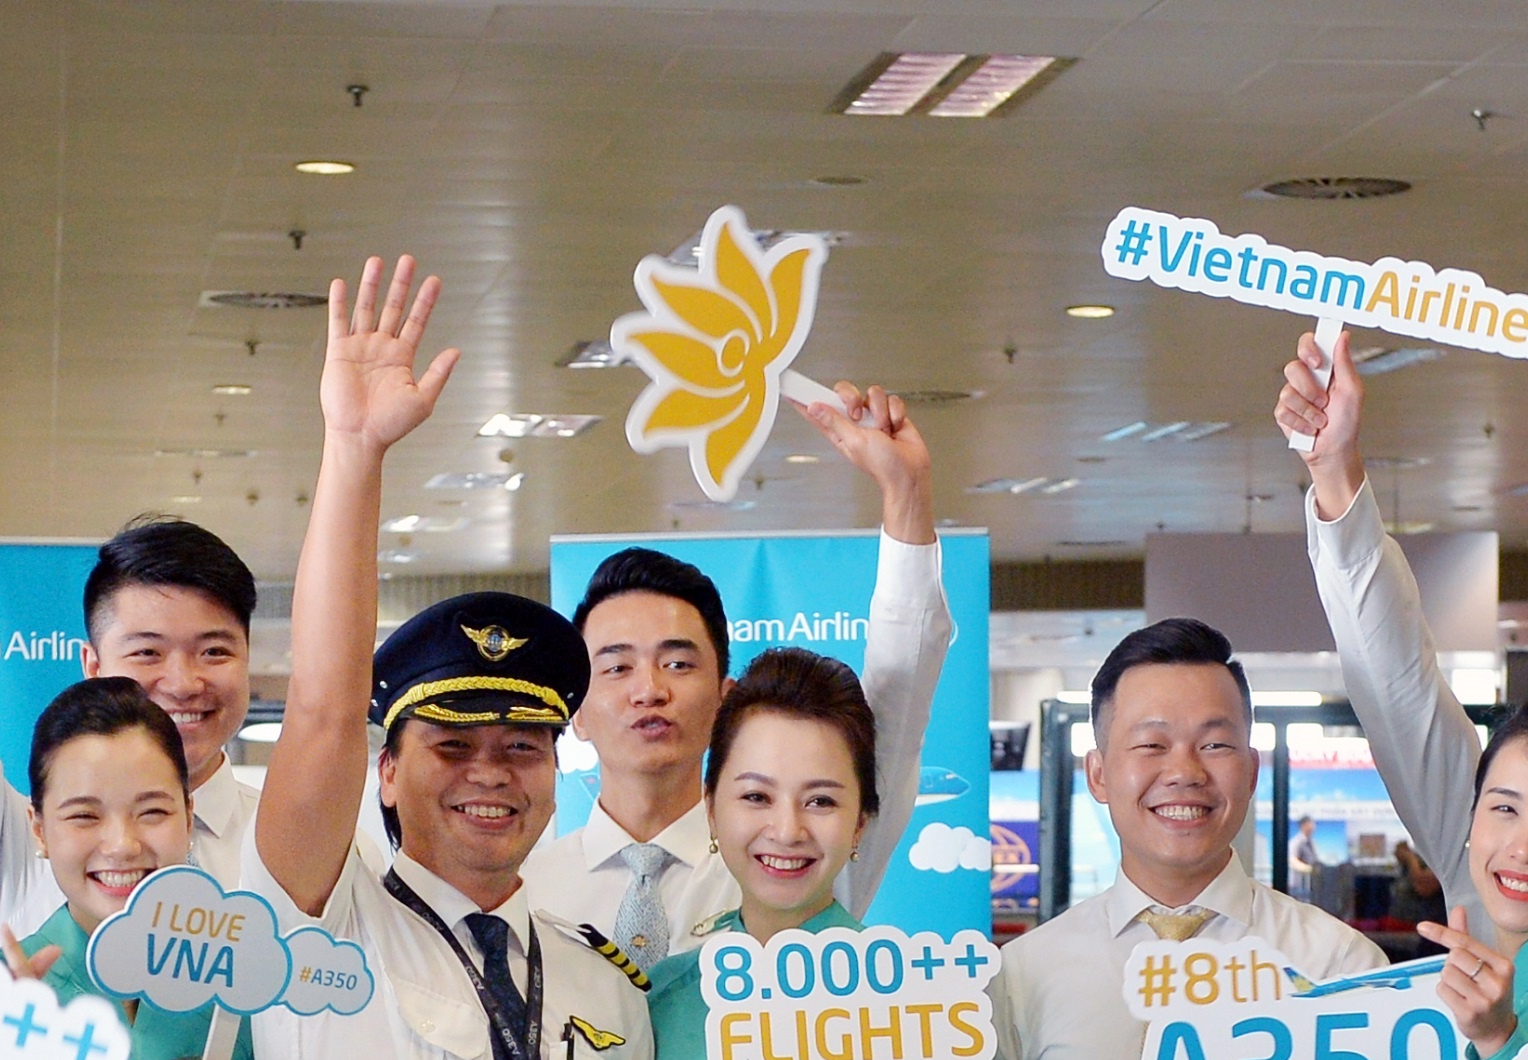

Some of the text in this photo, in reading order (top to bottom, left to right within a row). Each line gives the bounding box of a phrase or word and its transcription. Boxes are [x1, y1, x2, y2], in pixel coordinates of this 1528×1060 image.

[152, 901, 246, 942] I LOVE
[147, 933, 234, 988] VNA
[299, 966, 358, 991] #A350
[715, 937, 989, 1001] 8.000++
[1138, 950, 1283, 1008] #8th
